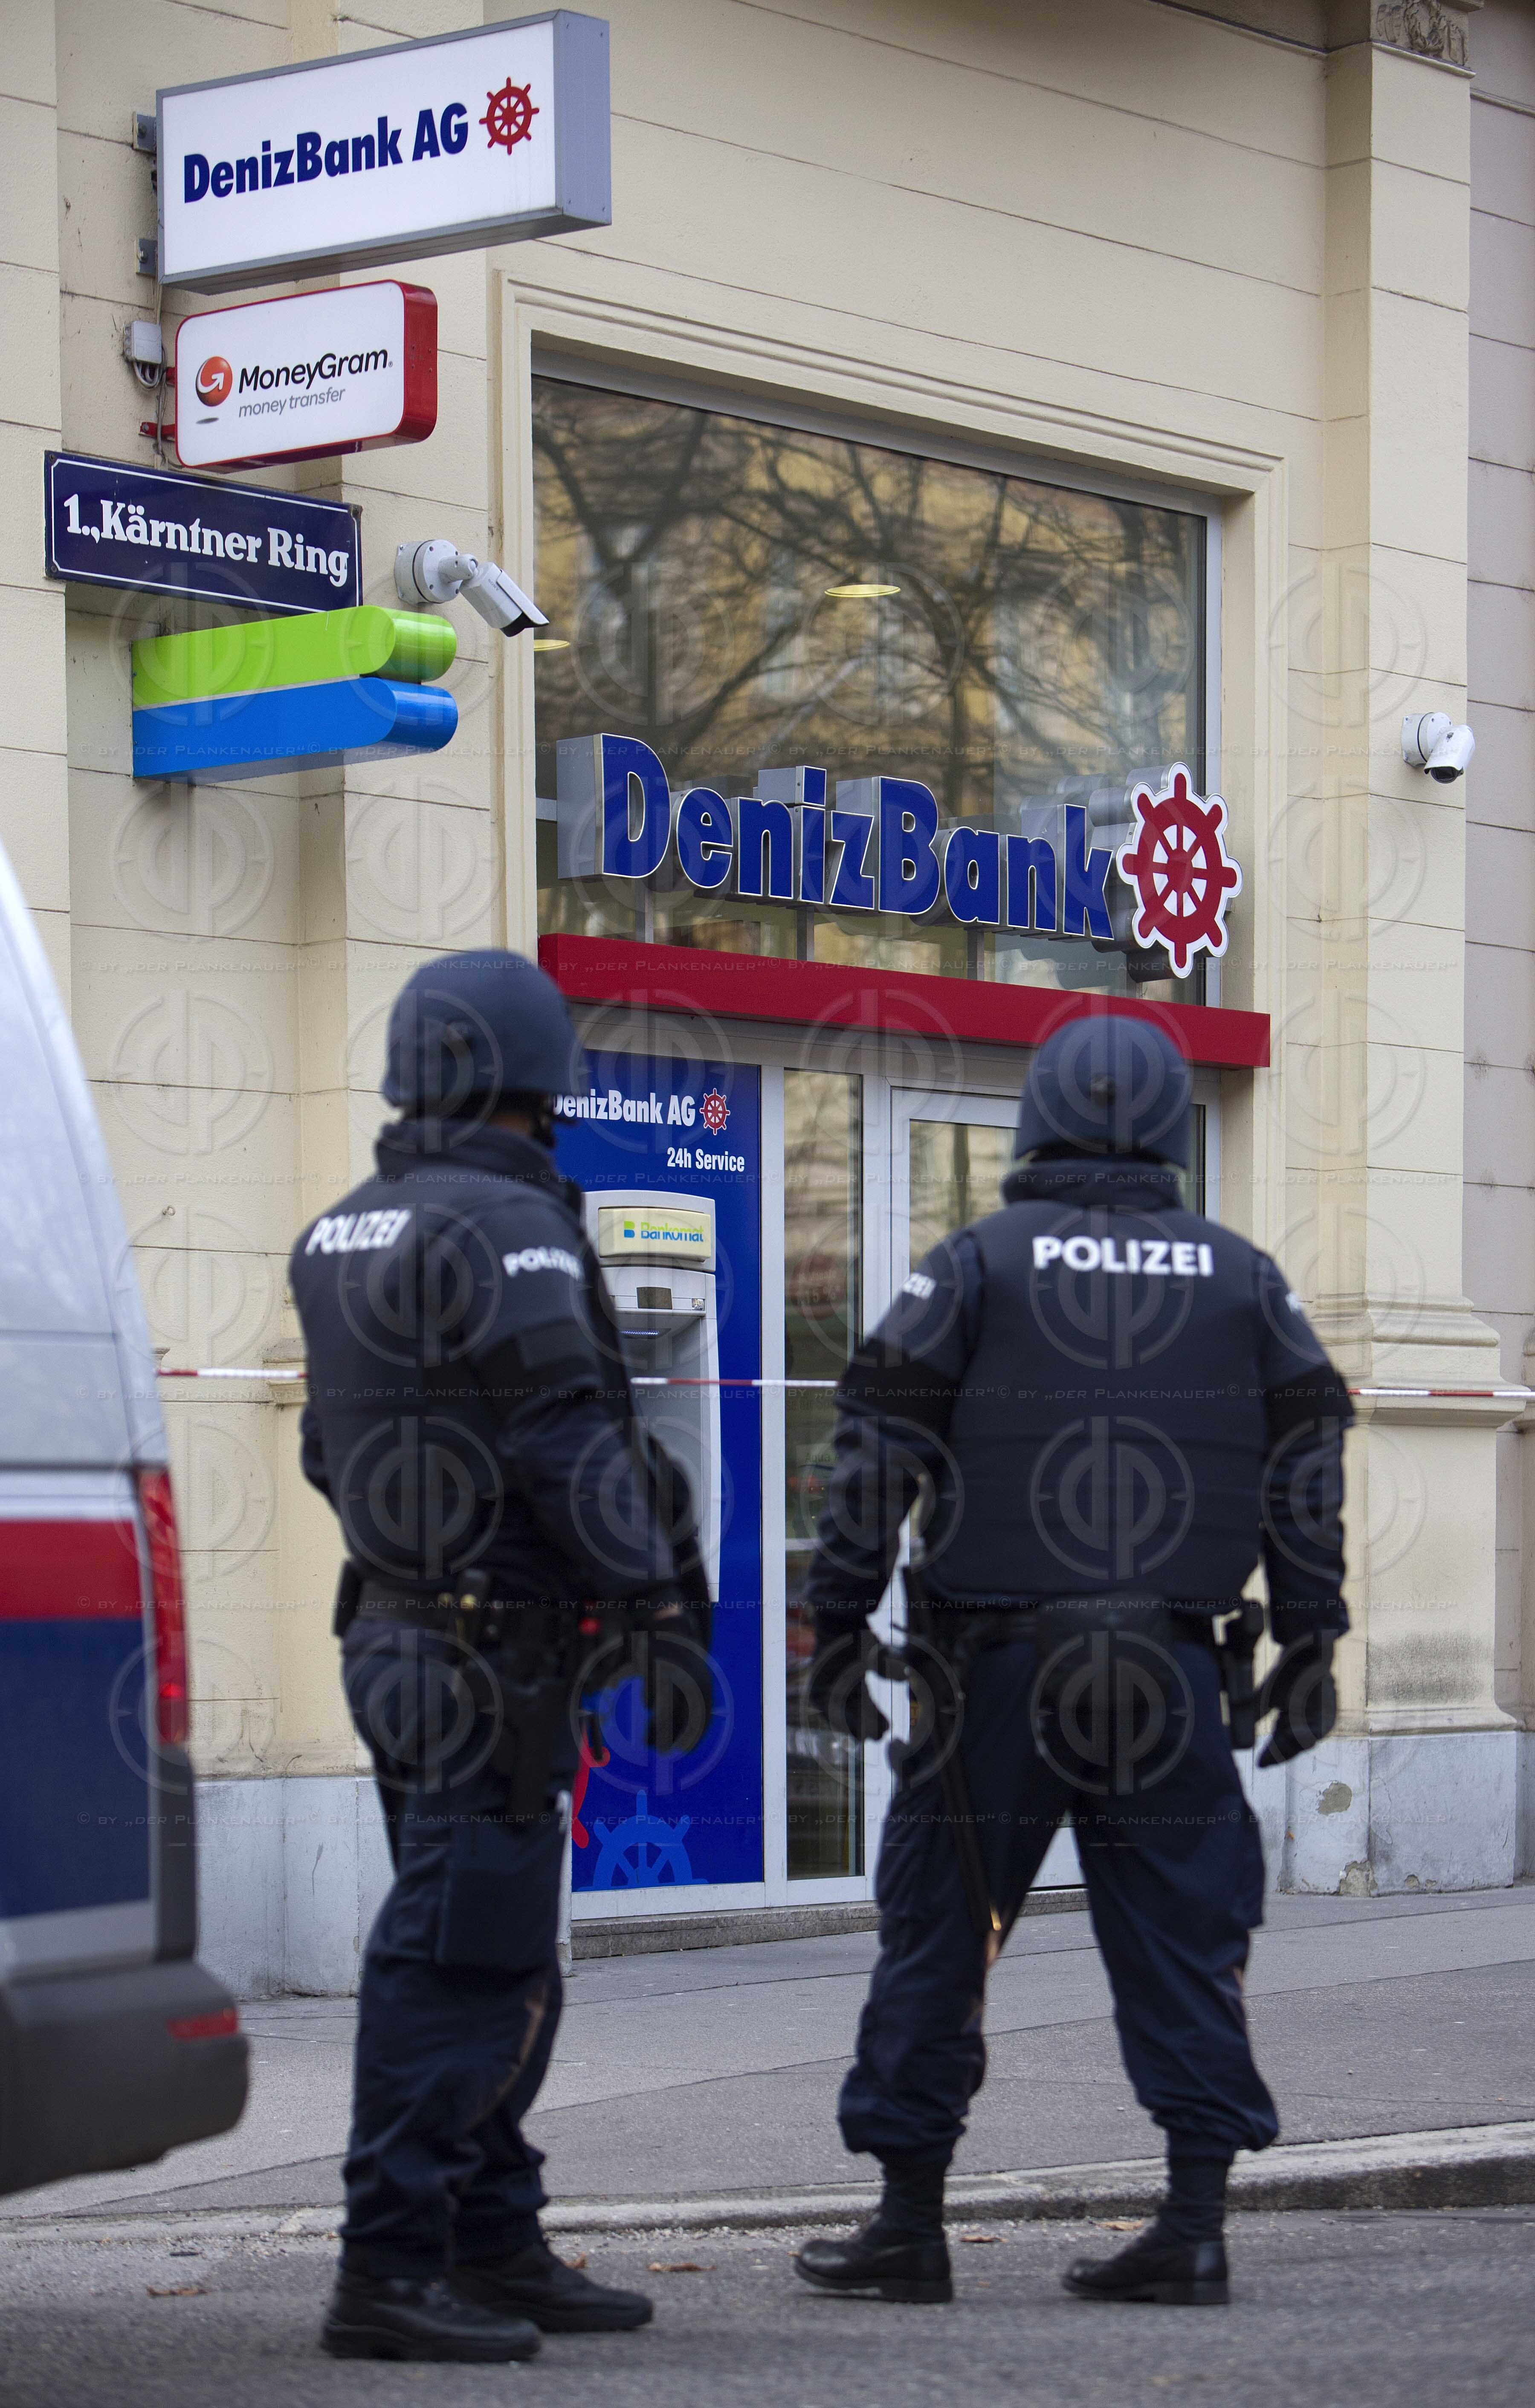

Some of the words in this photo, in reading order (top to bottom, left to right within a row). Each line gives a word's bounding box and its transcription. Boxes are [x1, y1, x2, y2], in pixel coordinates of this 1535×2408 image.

[185, 116, 402, 203] DenizBank
[412, 103, 469, 162] AG
[239, 399, 287, 418] money
[289, 387, 346, 409] transfer
[268, 527, 349, 588] Ring
[601, 733, 1114, 941] DenizBank
[667, 1094, 695, 1126] AG
[667, 1147, 691, 1168] 24h
[696, 1149, 745, 1172] Service
[304, 1209, 411, 1256] POLIZEI
[640, 1221, 704, 1242] Bankomat
[1032, 1236, 1214, 1276] POLIZEI
